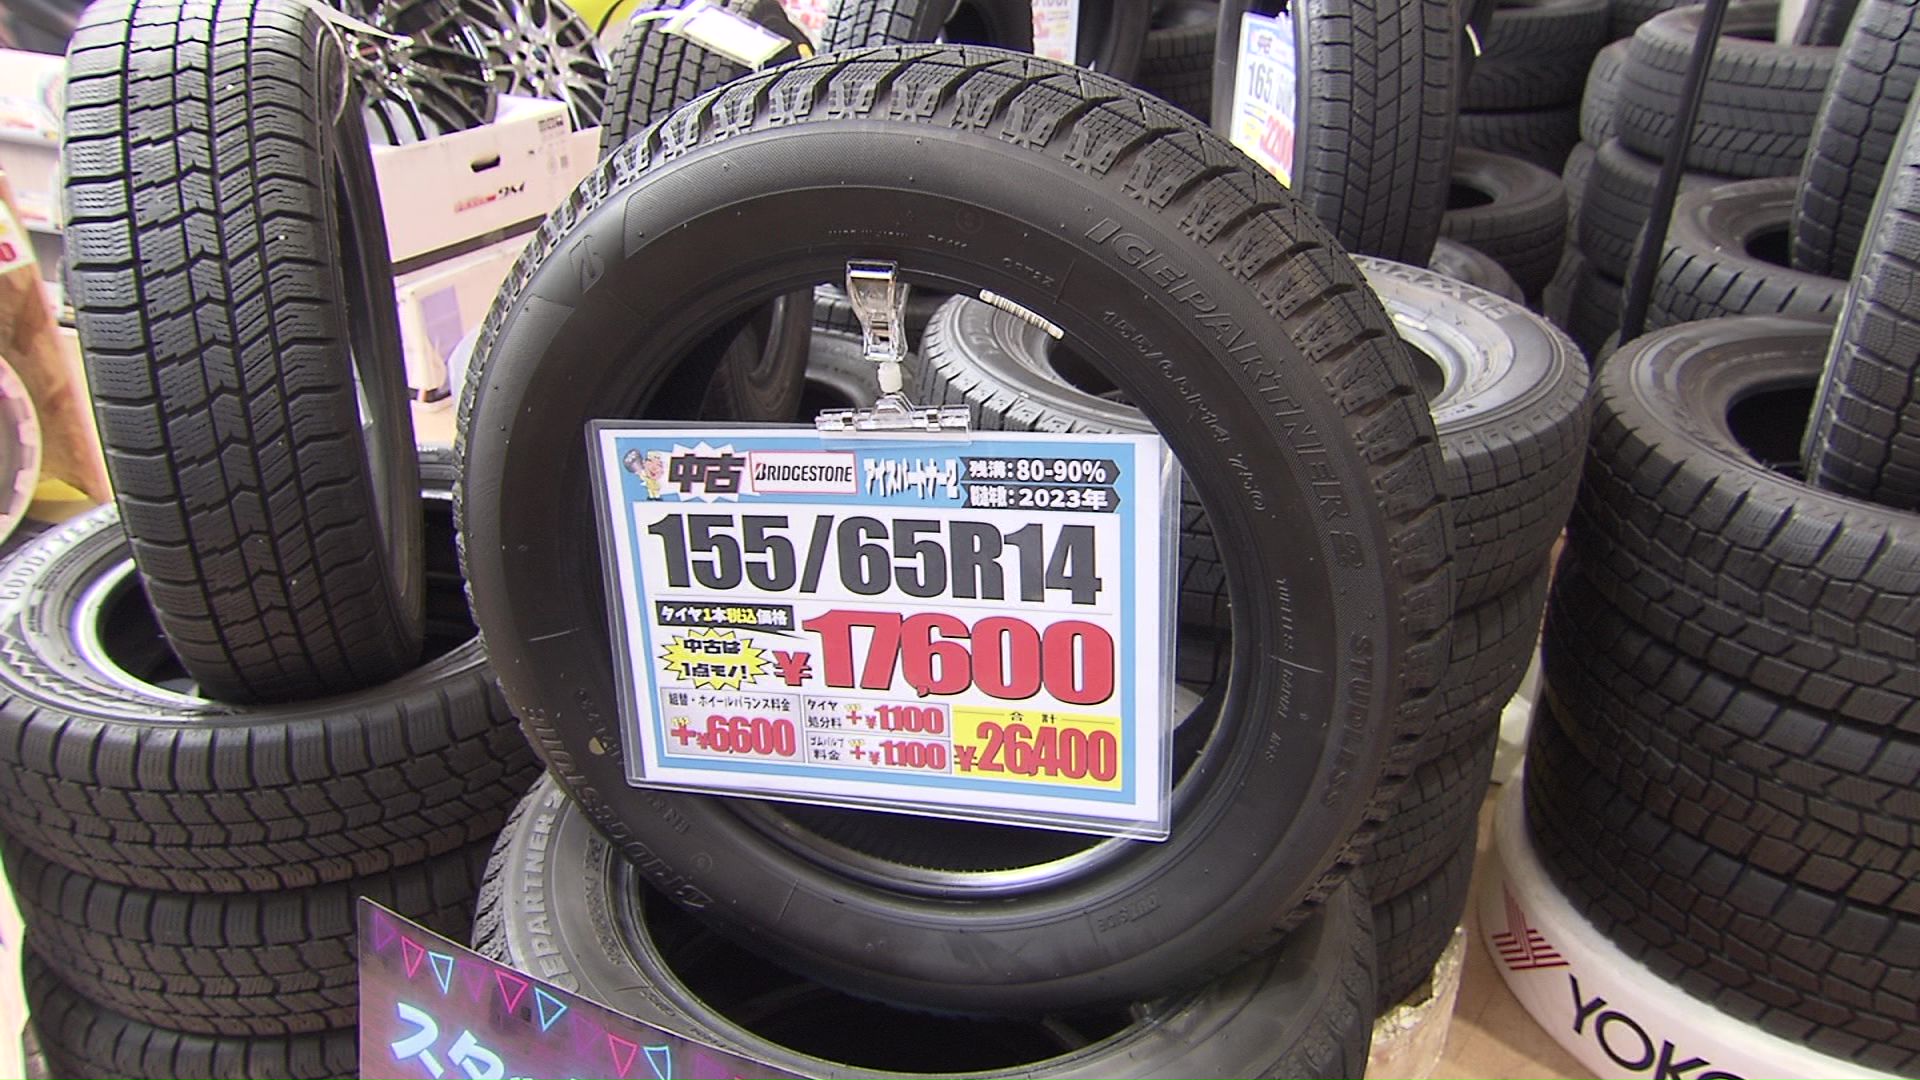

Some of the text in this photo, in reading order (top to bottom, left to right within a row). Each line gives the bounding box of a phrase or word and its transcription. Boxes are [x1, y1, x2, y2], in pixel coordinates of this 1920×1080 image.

[1085, 218, 1349, 520] ICEPARTNER
[669, 453, 745, 493] 中古
[755, 463, 852, 482] BRIDGESTONE
[648, 513, 1102, 605] 155/65R14
[661, 605, 788, 626] タイヤ1本税込価格
[683, 638, 741, 654] 中古は
[807, 699, 838, 711] タイヤ
[808, 716, 842, 728] 処分料
[813, 750, 841, 761] 料金
